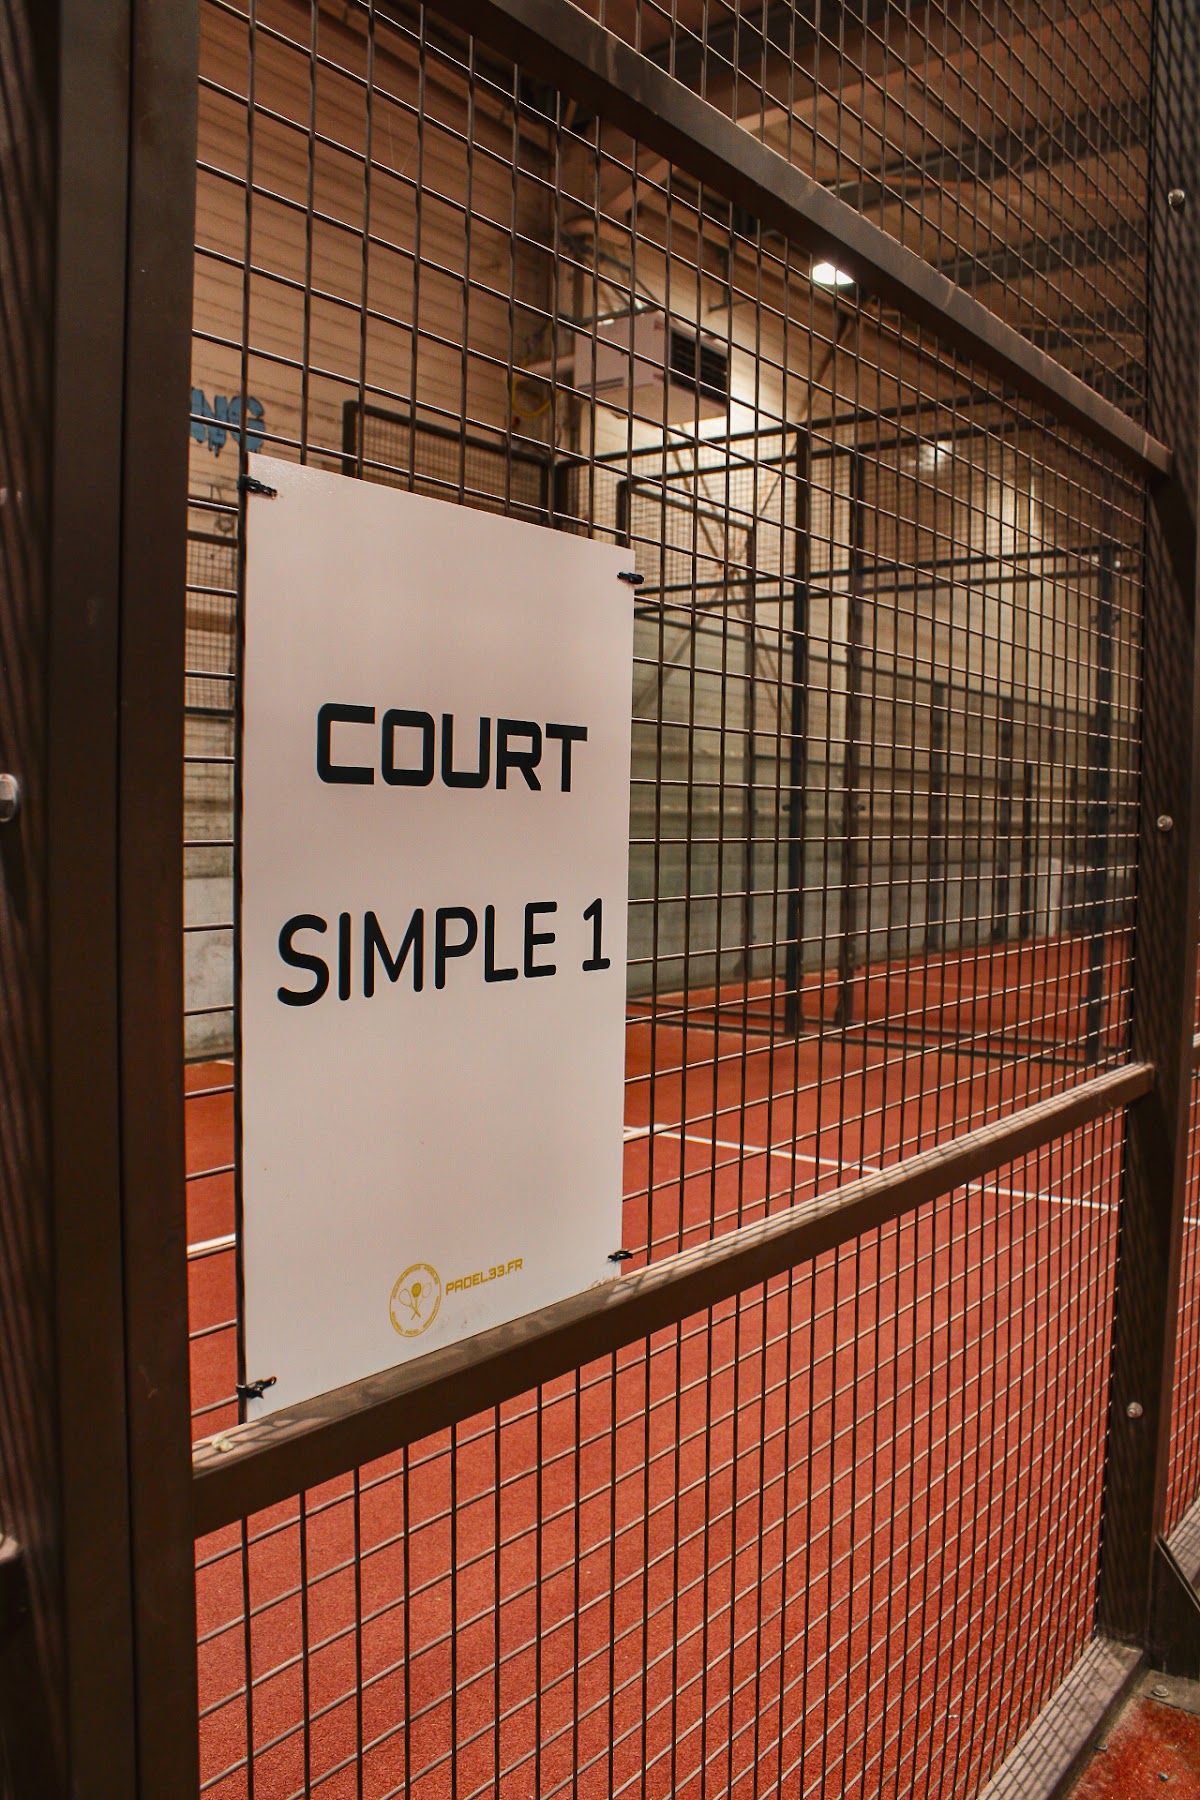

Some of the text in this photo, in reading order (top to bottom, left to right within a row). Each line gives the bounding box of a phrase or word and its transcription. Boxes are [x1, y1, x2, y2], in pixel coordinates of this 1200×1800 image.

[317, 702, 588, 792] COURT
[277, 898, 611, 1007] SIMPLE 1
[445, 1258, 523, 1296] PADEL33.FR
